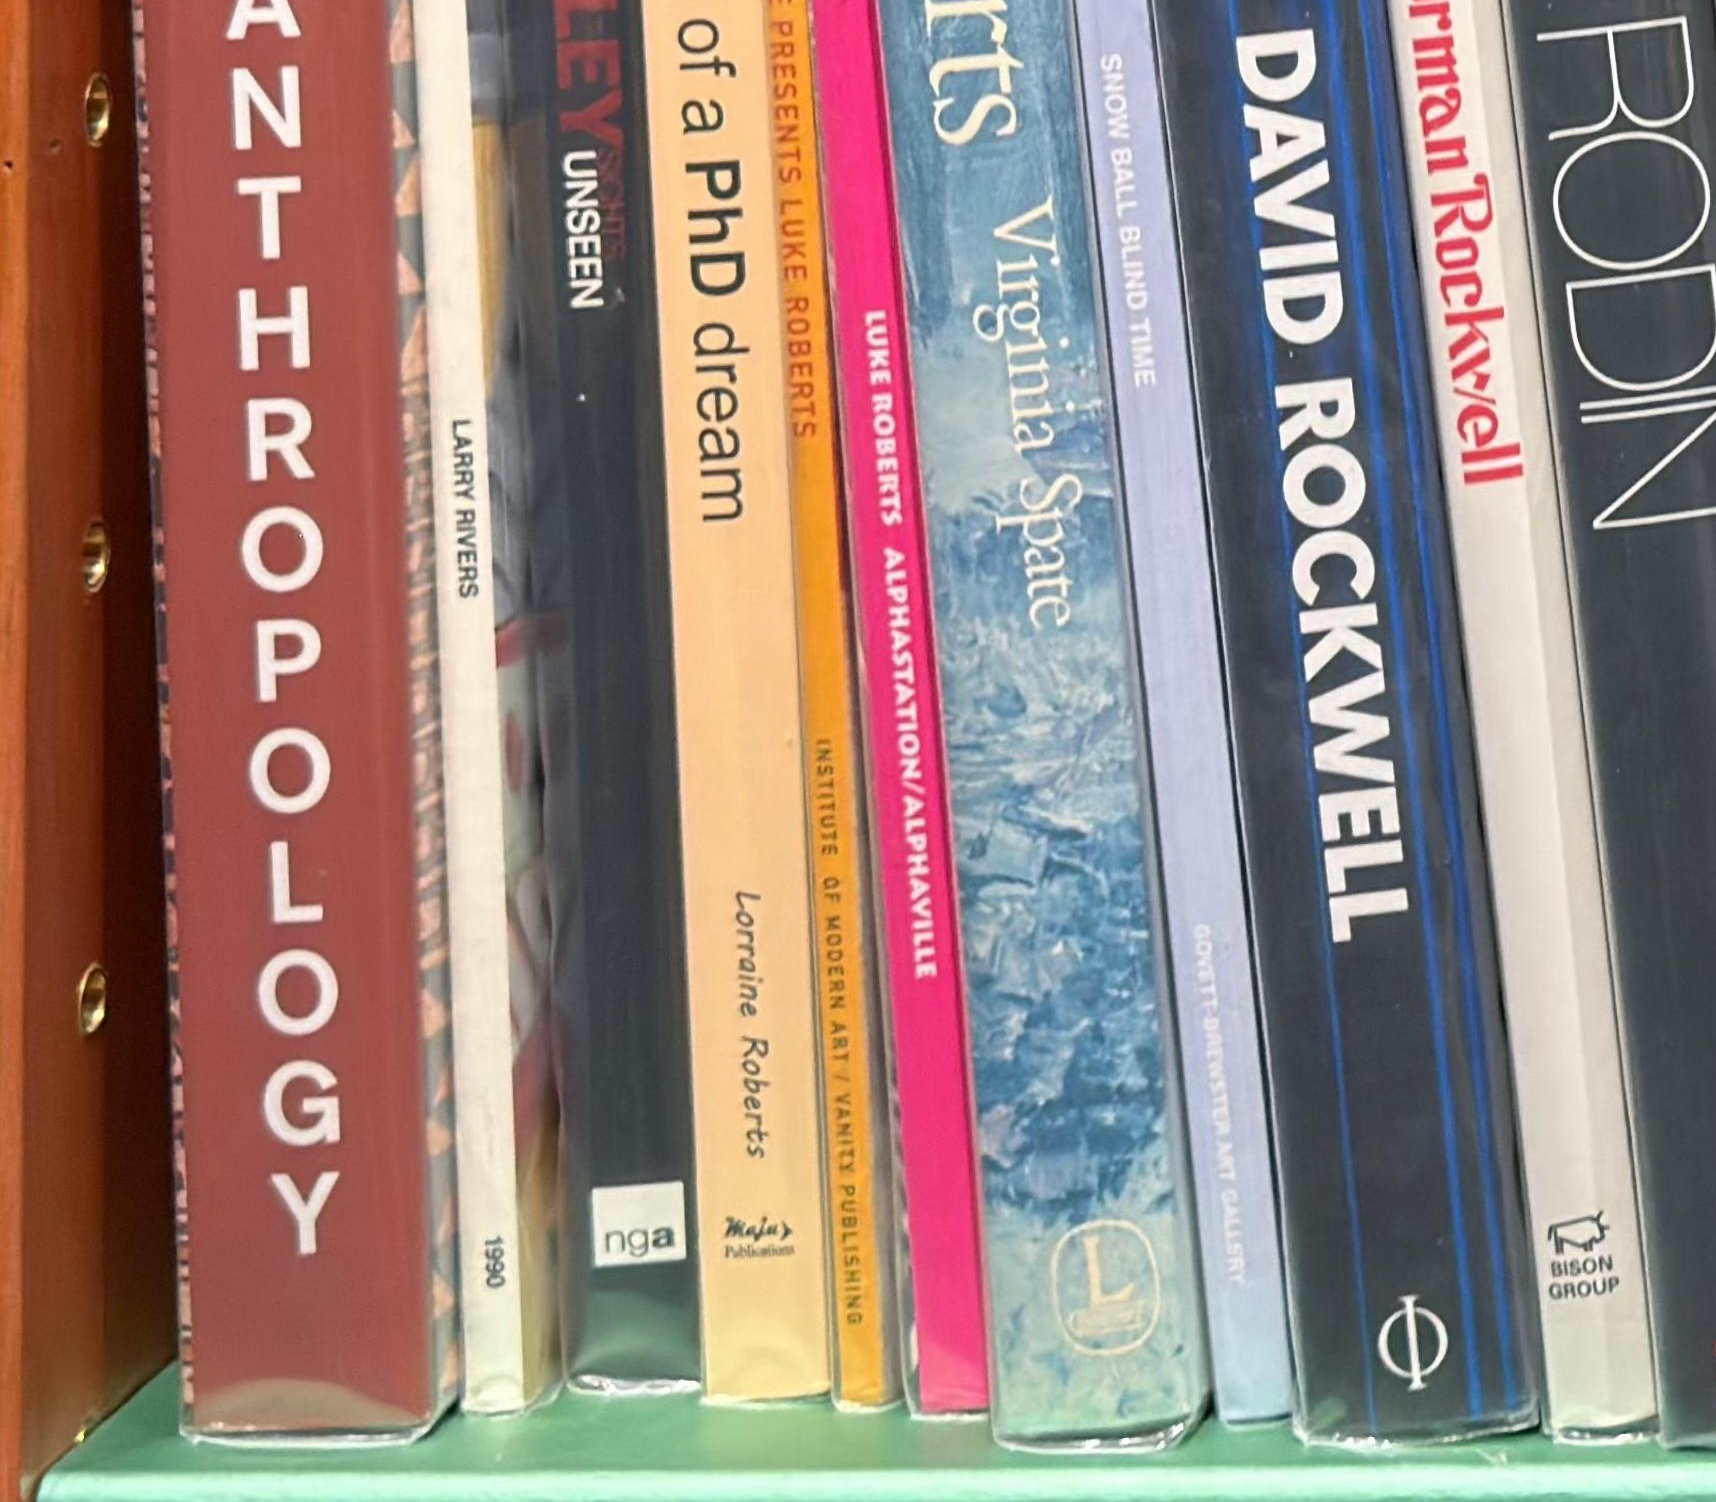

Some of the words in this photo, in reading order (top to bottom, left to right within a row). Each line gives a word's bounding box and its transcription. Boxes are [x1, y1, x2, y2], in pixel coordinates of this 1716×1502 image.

[676, 16, 740, 79] of
[683, 97, 724, 135] a
[769, 20, 802, 185] PRESENTS
[1100, 54, 1133, 140] SNOW
[1110, 144, 1143, 220] BALL
[1235, 28, 1345, 346] DAVID
[561, 150, 604, 309] UNSEEN
[686, 159, 745, 298] PhD
[778, 198, 809, 284] LUKE
[1118, 225, 1149, 312] BLIND
[785, 296, 817, 441] ROBERTS
[863, 309, 892, 387] LUKE
[973, 194, 1073, 457] Virginia
[1127, 316, 1158, 388] TIME
[1430, 172, 1525, 487] Rockwell
[451, 419, 475, 504] LARRY
[693, 323, 749, 524] dream
[871, 390, 903, 527] ROBERTS
[455, 508, 479, 599] RIVERS
[996, 473, 1083, 630] Spate
[1274, 376, 1409, 943] ROCKWELL
[815, 737, 838, 856] INSTITUTE
[882, 546, 938, 979] ALPHASTATION/ALPHAVILLE
[823, 875, 842, 904] OF
[733, 890, 760, 1019] Lorraine
[824, 914, 847, 1010] MODERN
[829, 1020, 850, 1064] ART
[740, 1034, 774, 1160] Roberts
[835, 1091, 856, 1175] VANITY
[1216, 1140, 1236, 1181] ART
[485, 1235, 506, 1289] 1990
[605, 1226, 676, 1258] nga
[724, 1243, 796, 1260] Publications
[840, 1183, 863, 1326] PUBLISHING
[1221, 1188, 1246, 1285] GALLERY
[1550, 1254, 1614, 1278] BISON
[1548, 1276, 1621, 1301] GROUP
